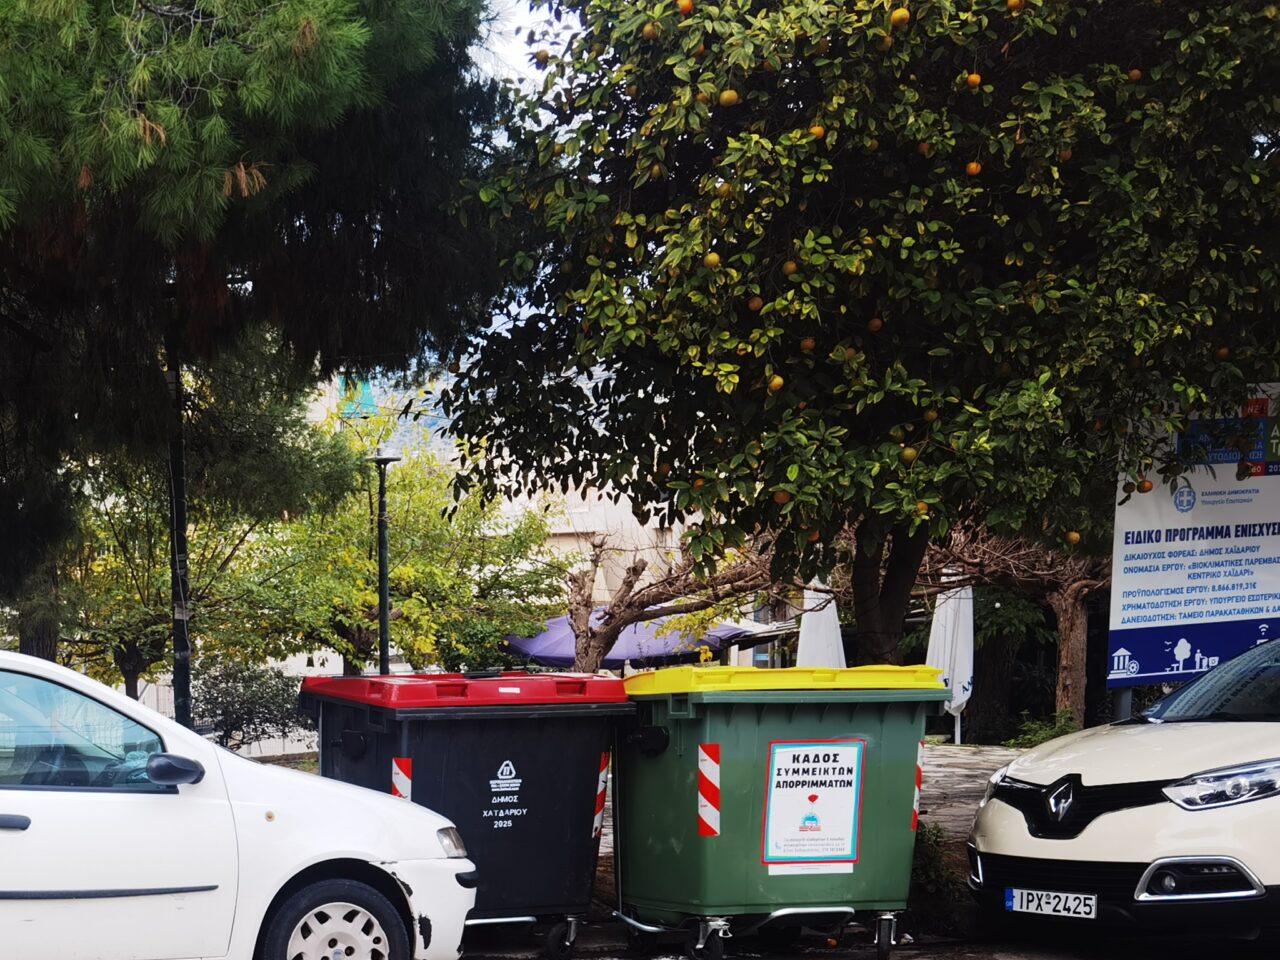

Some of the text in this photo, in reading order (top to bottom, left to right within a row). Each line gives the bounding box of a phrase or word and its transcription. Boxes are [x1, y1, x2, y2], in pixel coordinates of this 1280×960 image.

[1124, 529, 1162, 545] ΕΙΔΙΚΟ
[1165, 524, 1231, 543] ΠΡΟΓΡΑΜΜΑ
[1124, 545, 1261, 561] ΔΙΚΑΙΟΥΧΟΣ ΦΟΡΕΑΣ: ΔΗΜΟΣ ΧΑΪΔΑΡΙΟΥ
[1123, 564, 1160, 574] ΟΝΟΜΑΣΙΑ
[1161, 562, 1186, 572] ΕΡΓΟΥ:
[1187, 570, 1222, 580] ΚΕΝΤΡΙΚΟ
[1186, 585, 1210, 594] ΕΡΓΟΥ:
[1122, 599, 1182, 611] ΧΡΗΜΑΤΟΔΟΤΗΣΗ
[1183, 598, 1208, 607] ΕΡΓΟΥ:
[1210, 595, 1246, 605] ΥΠΟΥΡΓΕΙΟ
[1121, 613, 1177, 624] ΔΑΝΕΙΟΔΟΤΗΣΗ:
[1178, 610, 1204, 619] ΤΑΜΕΙΟ
[1205, 606, 1264, 619] ΠΑΡΑΚΑΤΑΘΗΚΩΝ
[792, 753, 840, 764] ΚΑΔΟΣ
[776, 767, 854, 777] ΣΥΜΜΕΙΚΤΩΝ
[775, 779, 853, 789] ΑΠΟΡΡΙΜΜΑΤΩΝ
[491, 795, 519, 803] ΔΗΜΟΣ
[493, 820, 513, 828] 2025
[1019, 891, 1094, 916] IPX-2425
